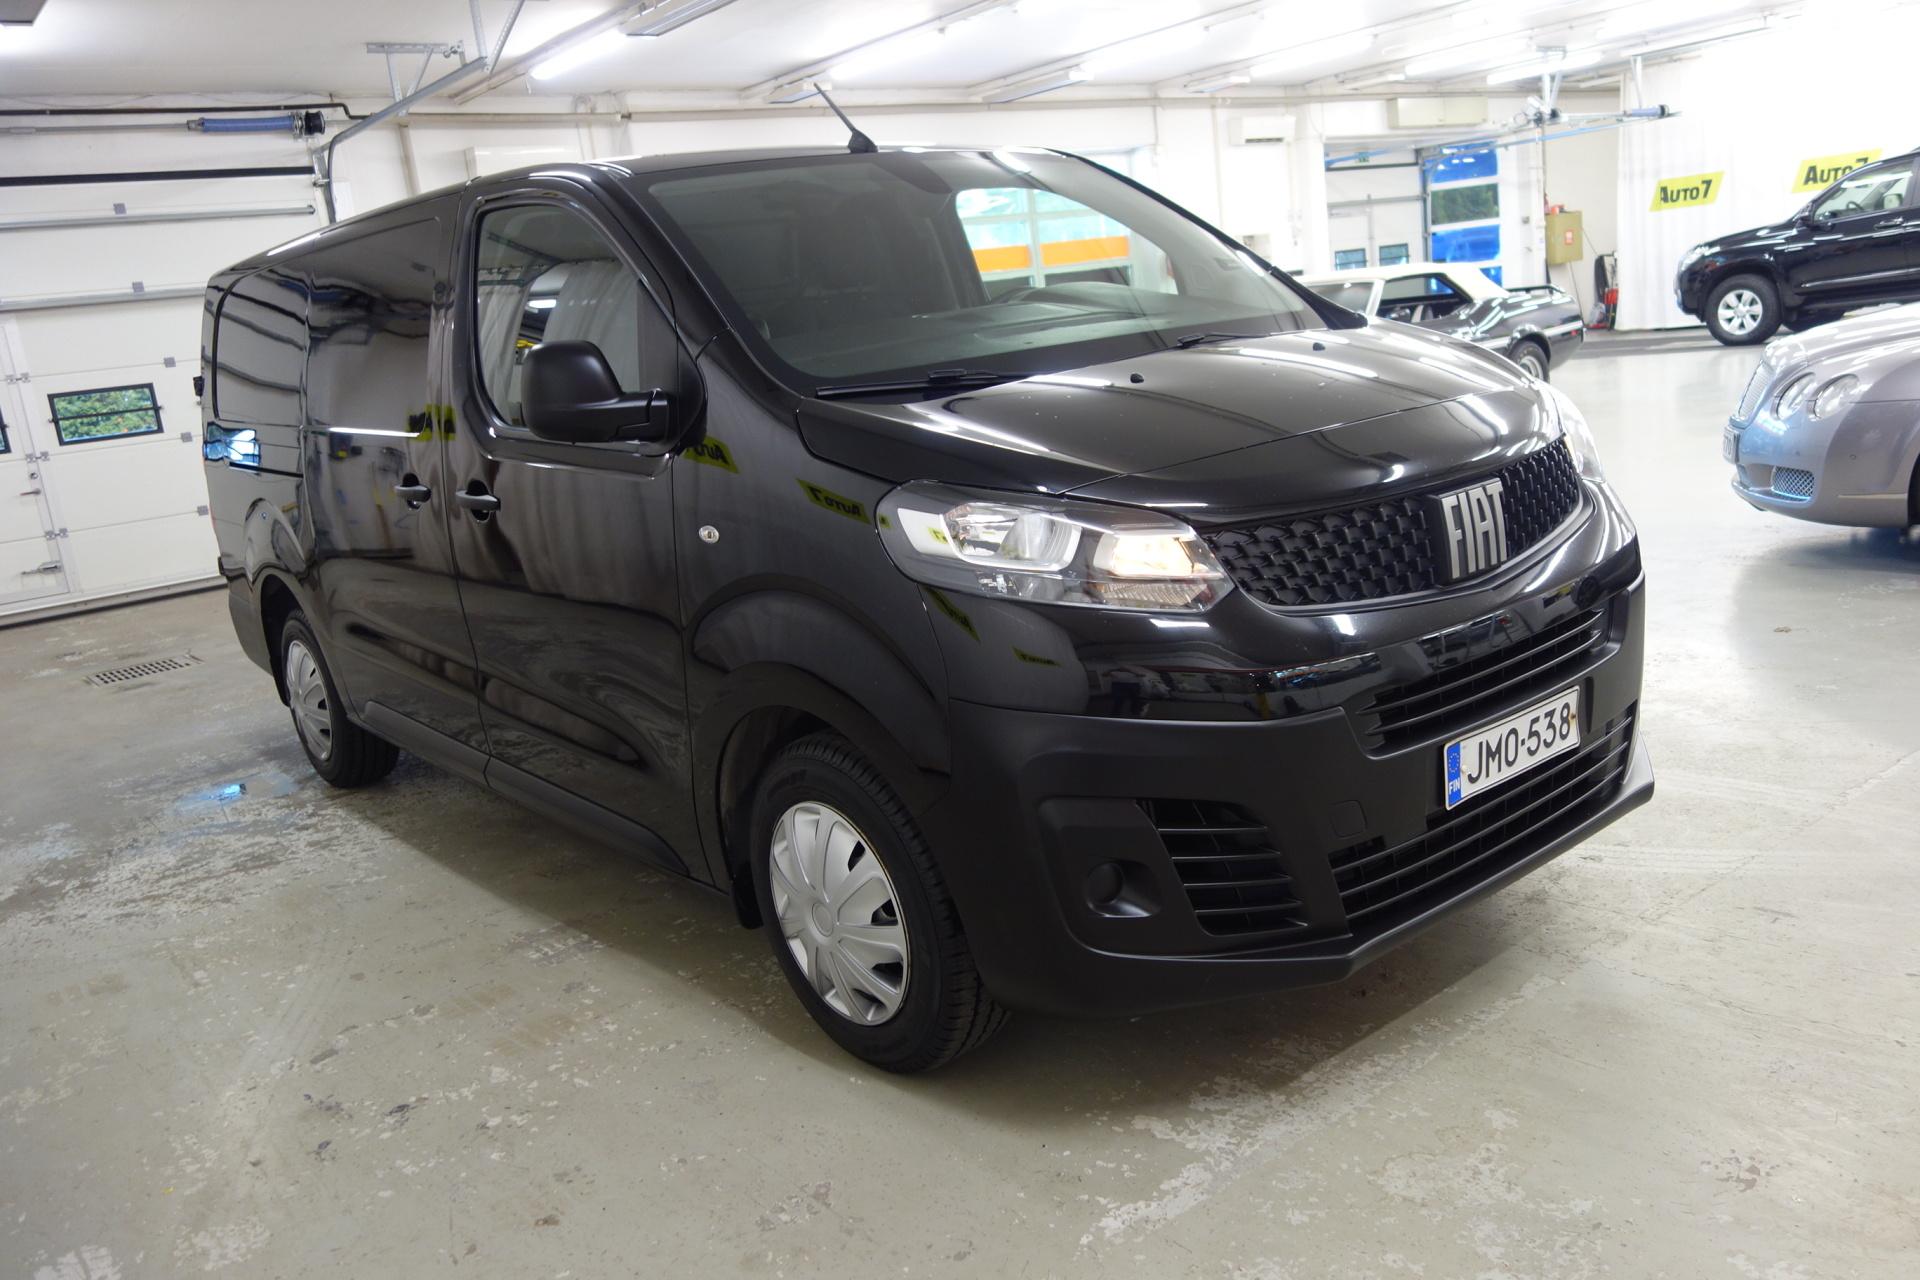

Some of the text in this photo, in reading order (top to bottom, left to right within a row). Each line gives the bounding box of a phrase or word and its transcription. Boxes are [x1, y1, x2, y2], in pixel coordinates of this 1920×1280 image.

[1442, 481, 1507, 579] FIAT
[1467, 702, 1571, 784] JMO-538
[1448, 777, 1461, 795] FIN
